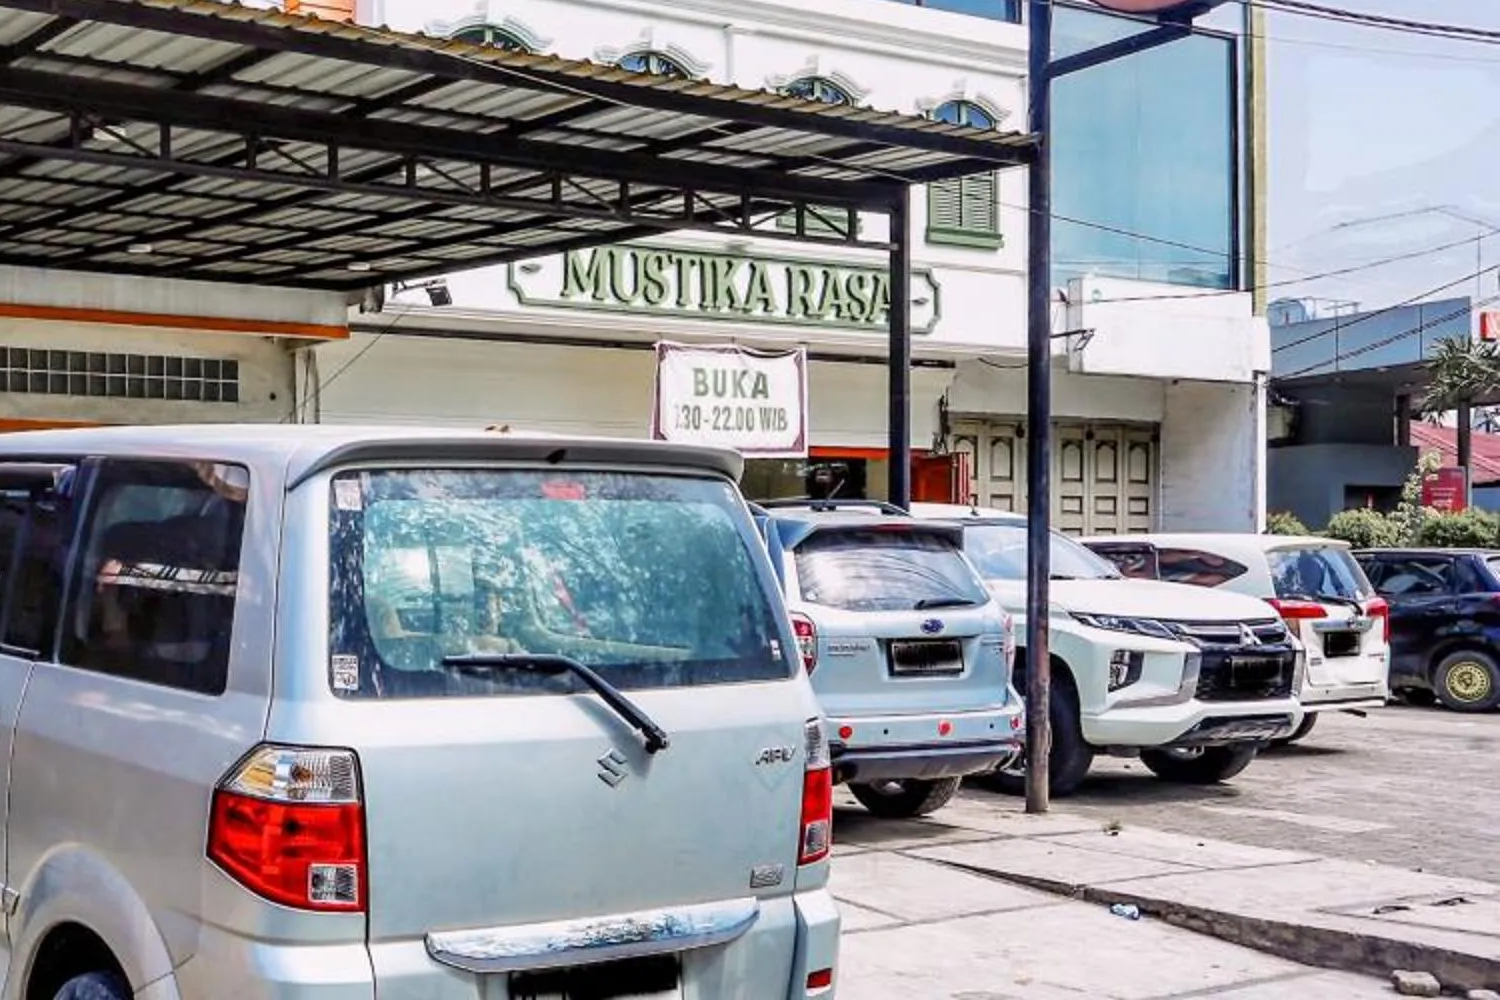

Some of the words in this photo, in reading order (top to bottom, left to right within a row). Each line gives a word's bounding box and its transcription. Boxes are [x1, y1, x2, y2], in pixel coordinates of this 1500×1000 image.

[560, 247, 775, 314] MUSTIKA
[692, 367, 769, 399] BUKA
[760, 407, 788, 431] WIB
